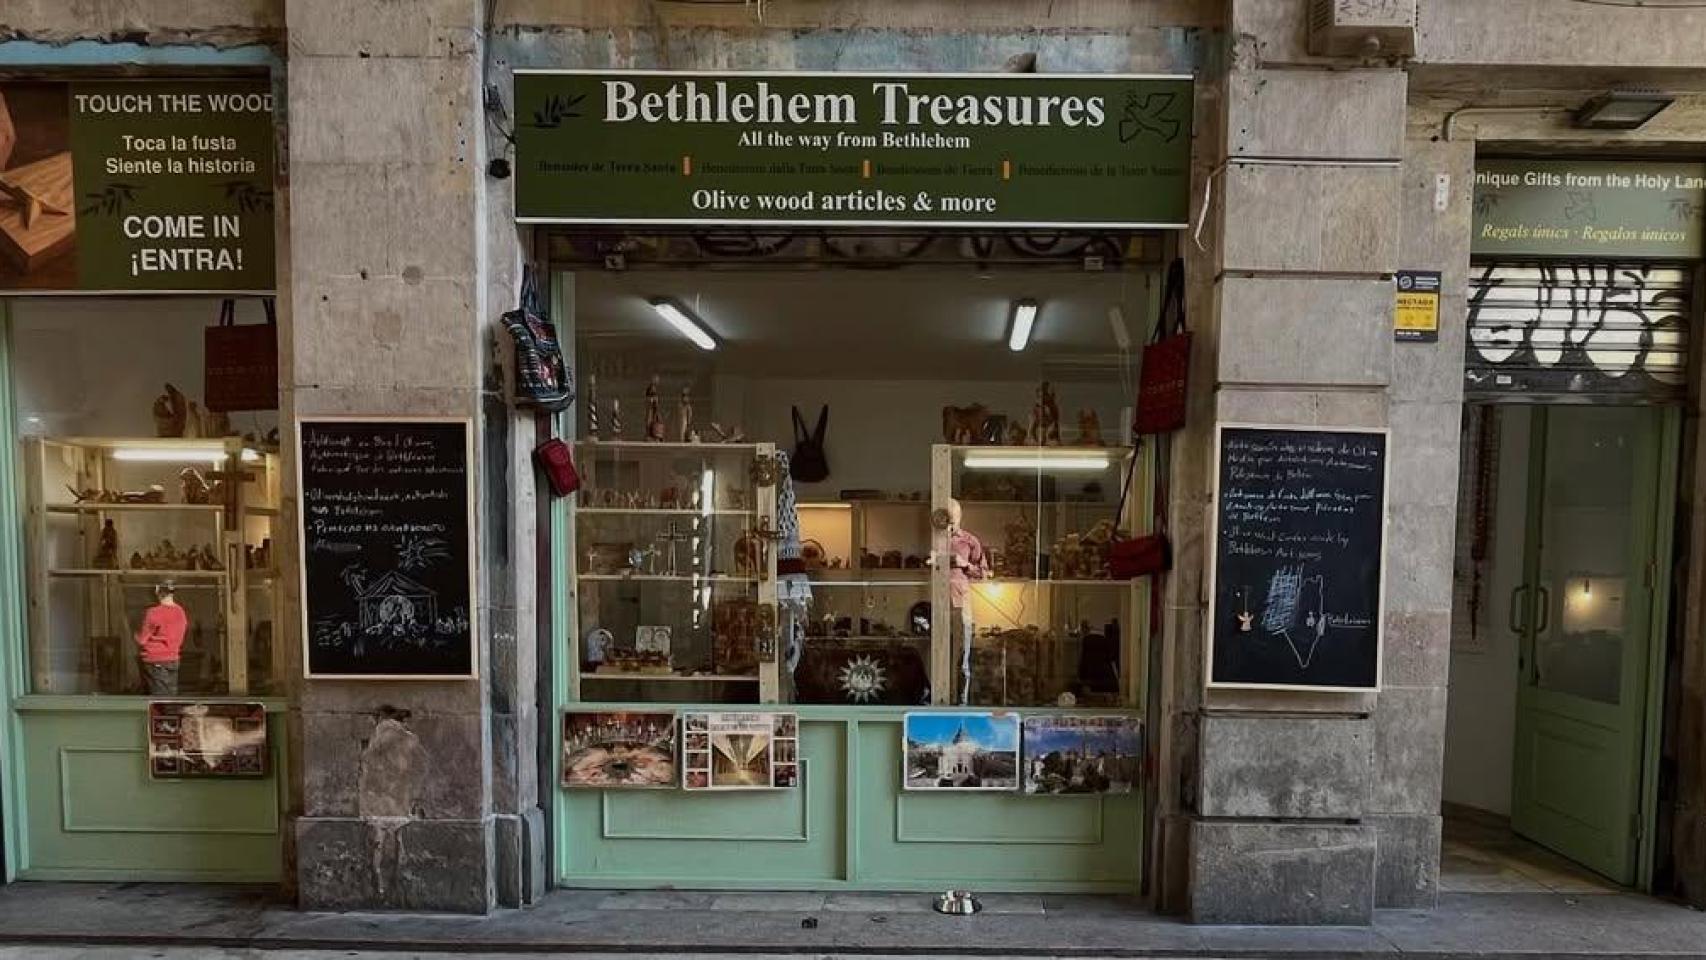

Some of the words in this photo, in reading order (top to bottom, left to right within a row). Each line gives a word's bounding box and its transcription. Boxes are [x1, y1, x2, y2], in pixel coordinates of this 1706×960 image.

[75, 94, 152, 113] TOUCH
[158, 94, 202, 113] THE
[602, 80, 857, 123] Bethlehem
[873, 82, 1105, 127] Treasures
[122, 134, 167, 151] Toca
[172, 135, 187, 151] la
[192, 135, 237, 151] fusta
[738, 131, 762, 147] All
[767, 131, 793, 147] the
[799, 135, 831, 150] way
[837, 131, 877, 147] from
[882, 131, 971, 148] Bethlehem
[106, 157, 162, 174] Siente
[167, 157, 183, 174] la
[188, 157, 255, 174] historia
[1473, 171, 1520, 189] nique
[1524, 171, 1560, 186] Gifts
[1566, 172, 1601, 187] from
[1606, 173, 1631, 188] the
[1635, 174, 1670, 191] Holy
[1675, 175, 1706, 189] Lan
[692, 189, 750, 210] Olive
[757, 190, 814, 210] wood
[821, 190, 907, 211] articles
[913, 191, 933, 211] &
[940, 196, 997, 212] more
[123, 215, 205, 238] COME
[213, 215, 240, 238] IN
[1481, 223, 1529, 241] Regals
[1583, 225, 1637, 243] Regalos
[130, 248, 243, 275] ¡ENTRA!
